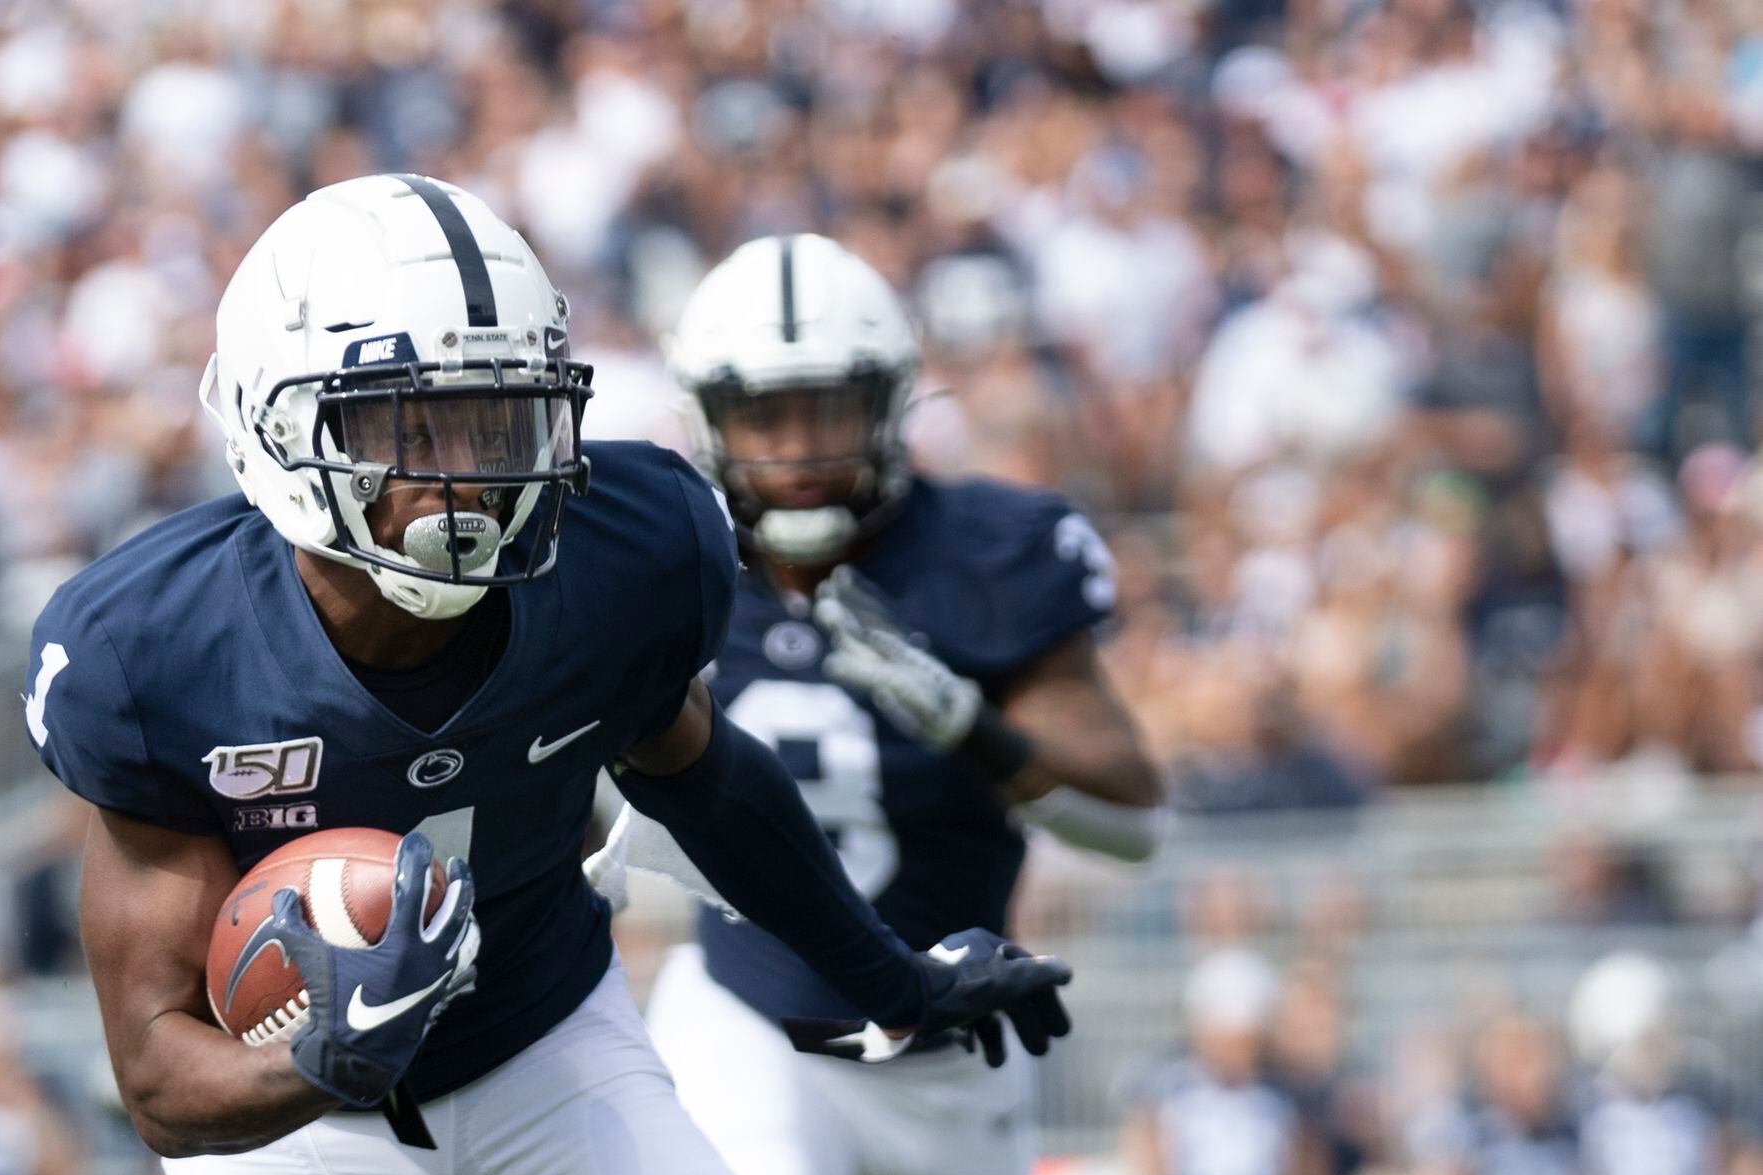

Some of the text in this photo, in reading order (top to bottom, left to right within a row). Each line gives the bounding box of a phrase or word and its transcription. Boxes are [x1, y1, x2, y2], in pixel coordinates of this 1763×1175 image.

[358, 337, 397, 364] NIKE
[486, 333, 508, 342] STATE
[25, 642, 70, 748] 1
[202, 736, 324, 800] 150
